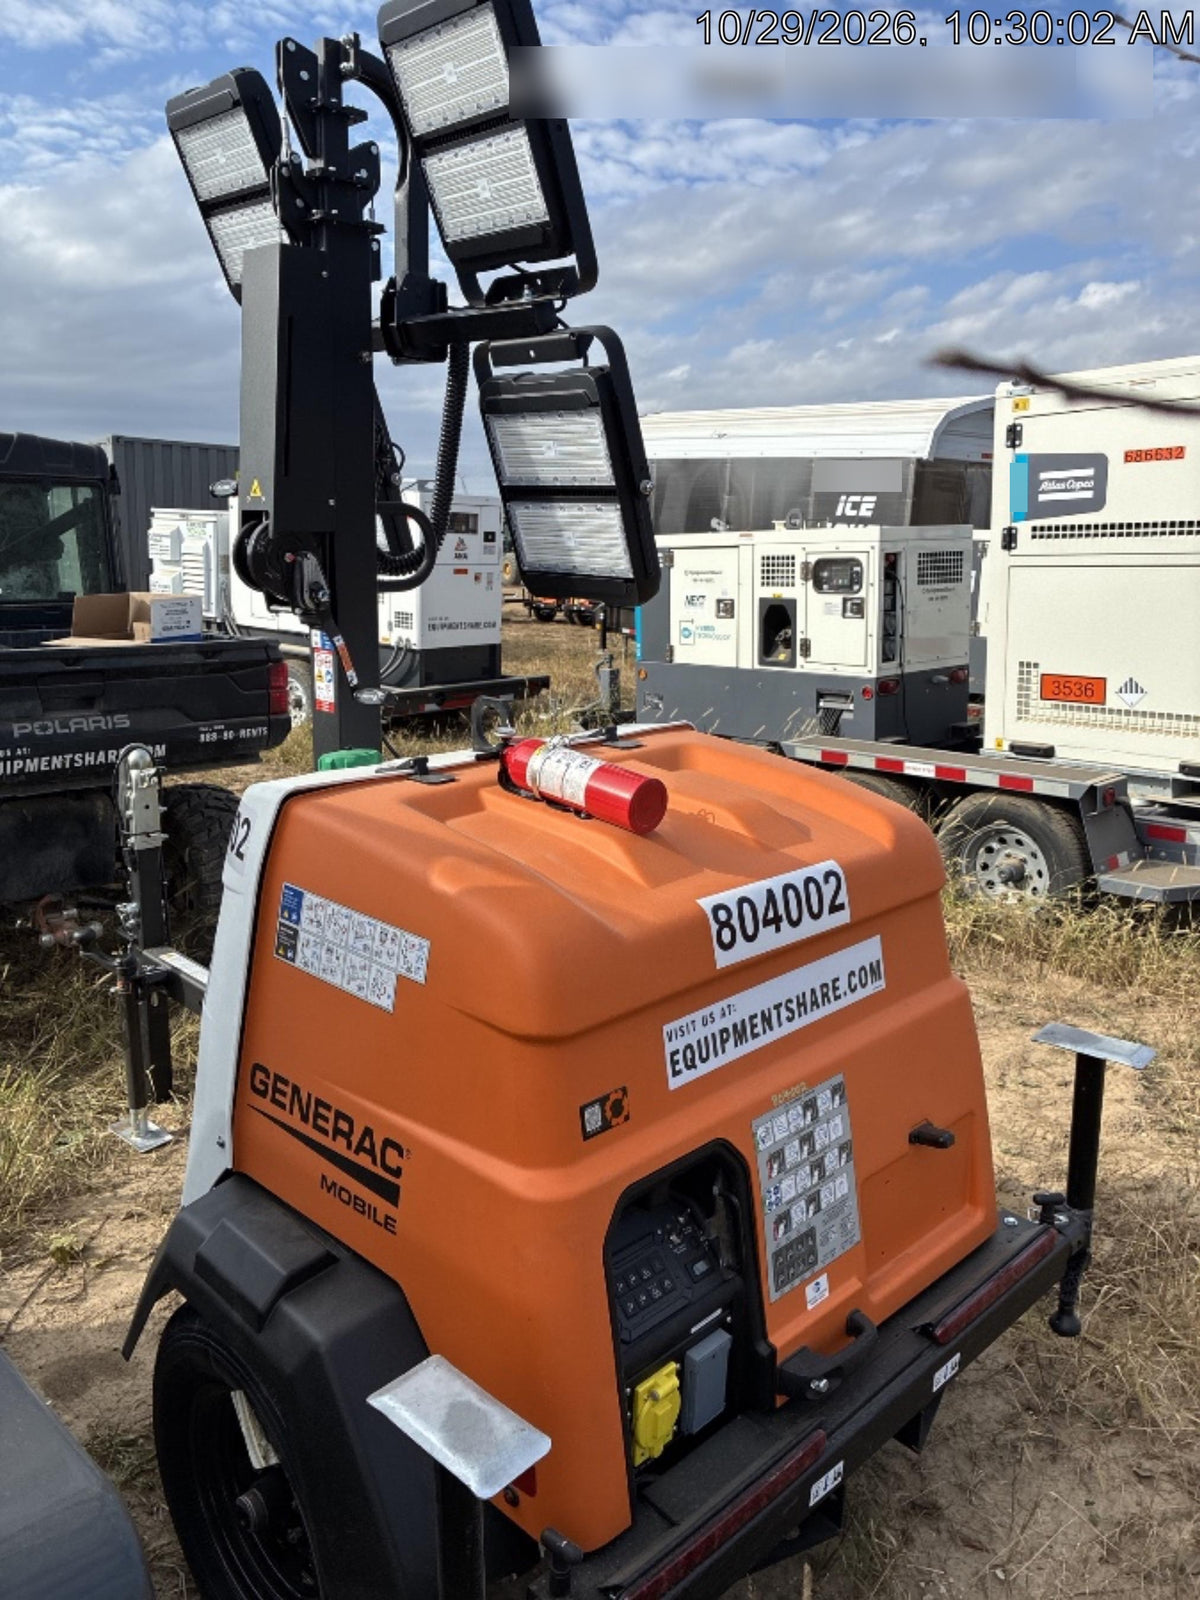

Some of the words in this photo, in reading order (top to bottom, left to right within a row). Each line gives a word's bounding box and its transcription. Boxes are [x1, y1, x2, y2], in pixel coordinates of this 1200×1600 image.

[1125, 446, 1185, 463] 686632
[1038, 480, 1066, 492] Atlas
[1067, 479, 1095, 492] Copco
[835, 495, 877, 517] ICE
[1052, 680, 1095, 698] 3536
[12, 714, 131, 738] POLARIS
[711, 869, 846, 952] 804002
[666, 1019, 697, 1043] VISIT
[701, 1010, 716, 1028] US
[720, 1003, 737, 1020] AT:
[669, 958, 883, 1078] EQUIPMENTSHARE.COM
[250, 1062, 404, 1180] GENERAC
[320, 1173, 398, 1236] MOBILE
